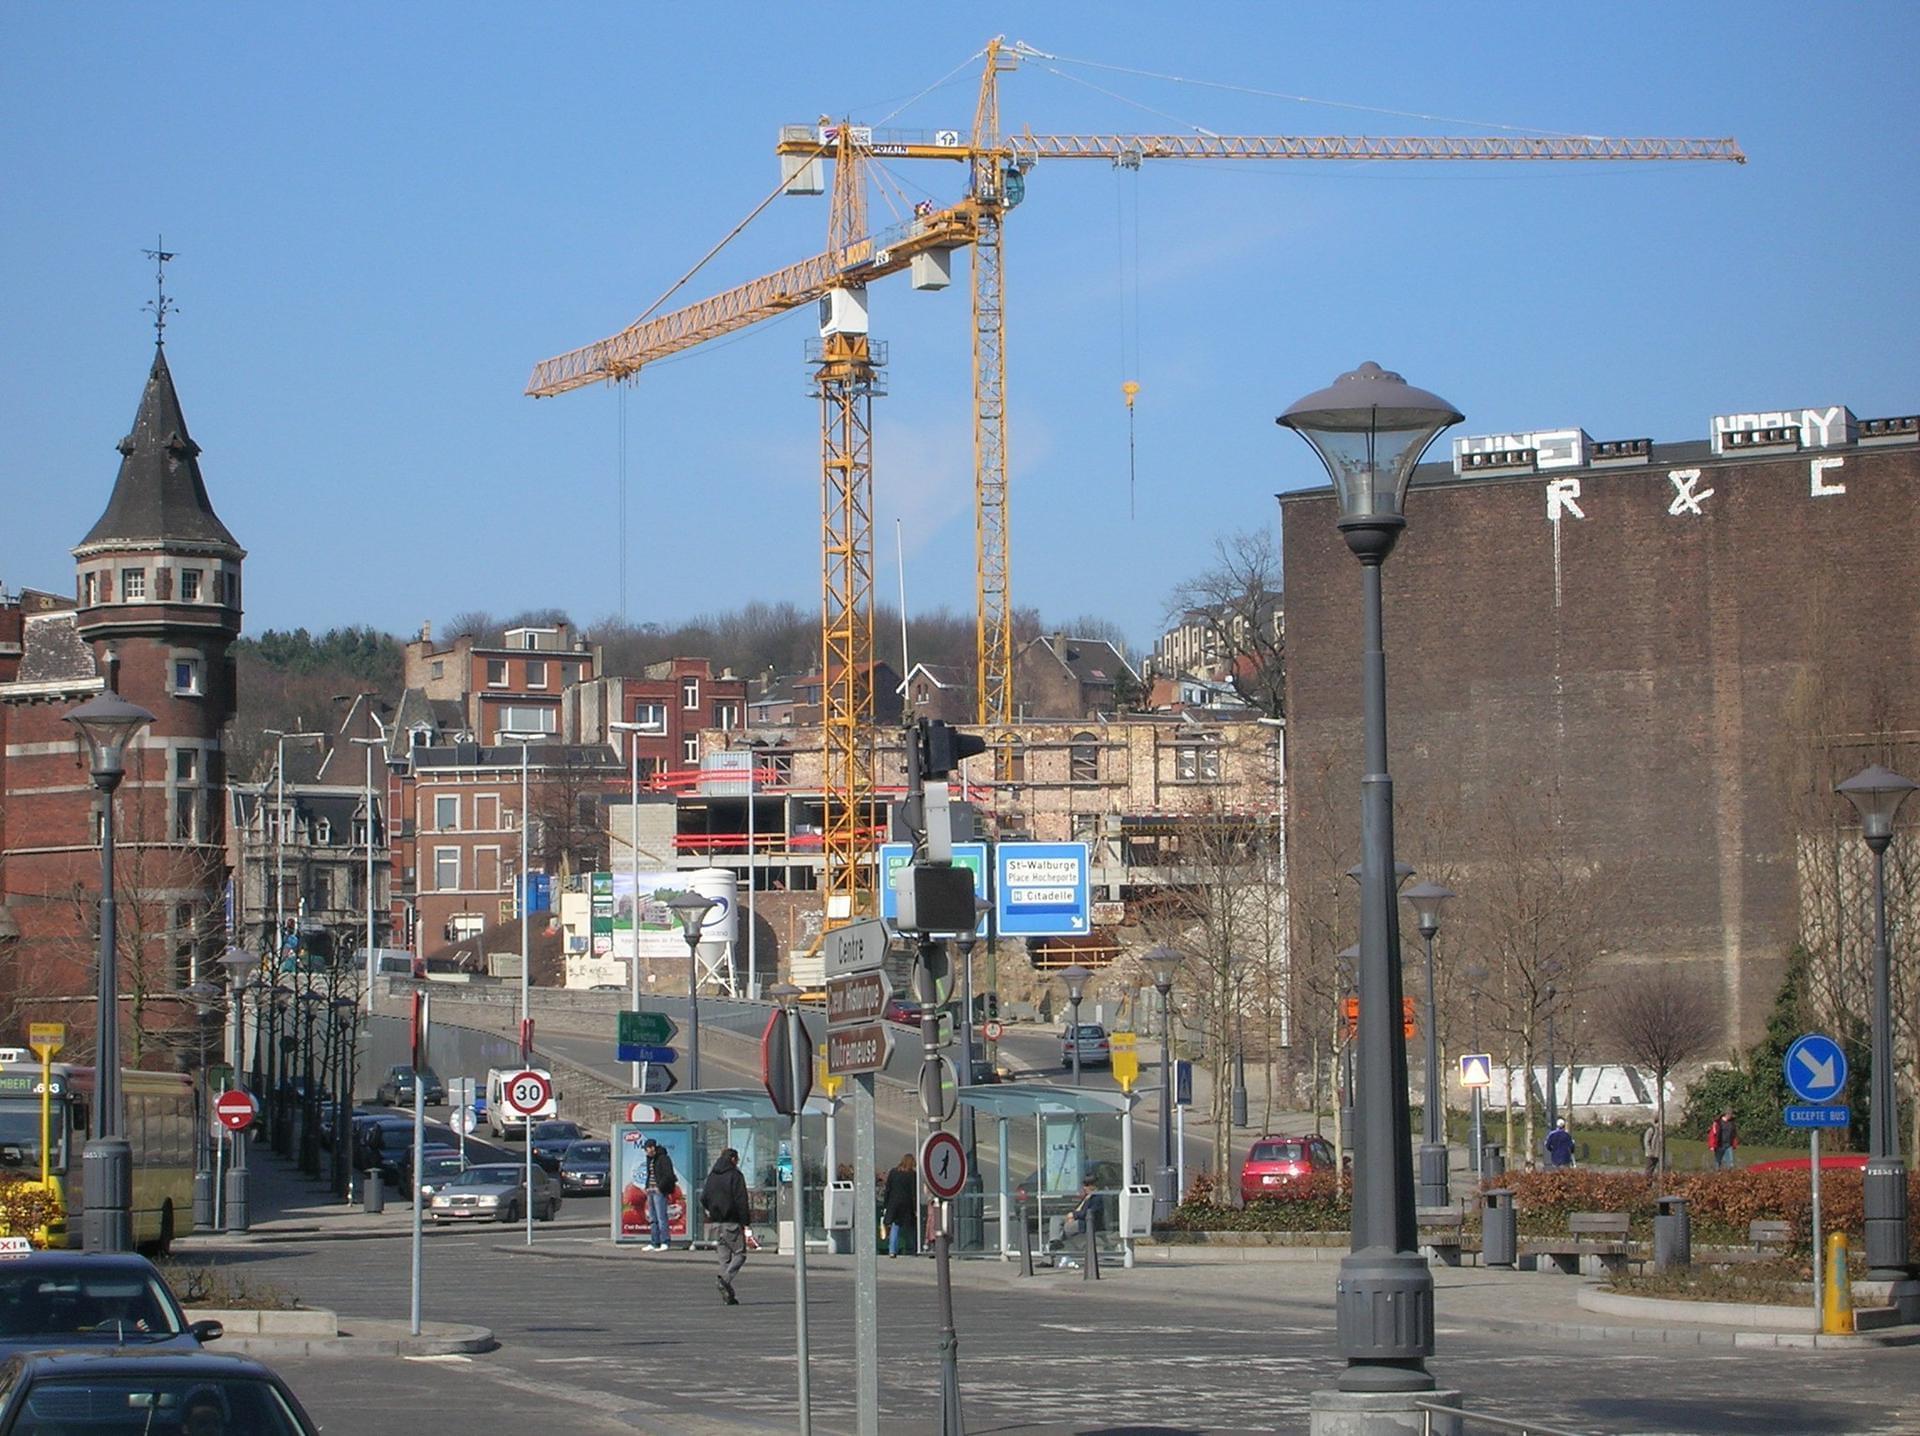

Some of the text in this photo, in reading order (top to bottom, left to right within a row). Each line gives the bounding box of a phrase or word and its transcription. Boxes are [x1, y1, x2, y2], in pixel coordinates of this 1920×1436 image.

[1008, 873, 1077, 883] Place Hocheporte
[1027, 891, 1073, 901] Citadelle
[838, 935, 864, 965] Centre
[846, 979, 880, 1017] Historique
[831, 1039, 877, 1068] Outremeuse
[516, 1084, 541, 1101] 30
[1790, 1110, 1847, 1121] EXCEPTE BUS
